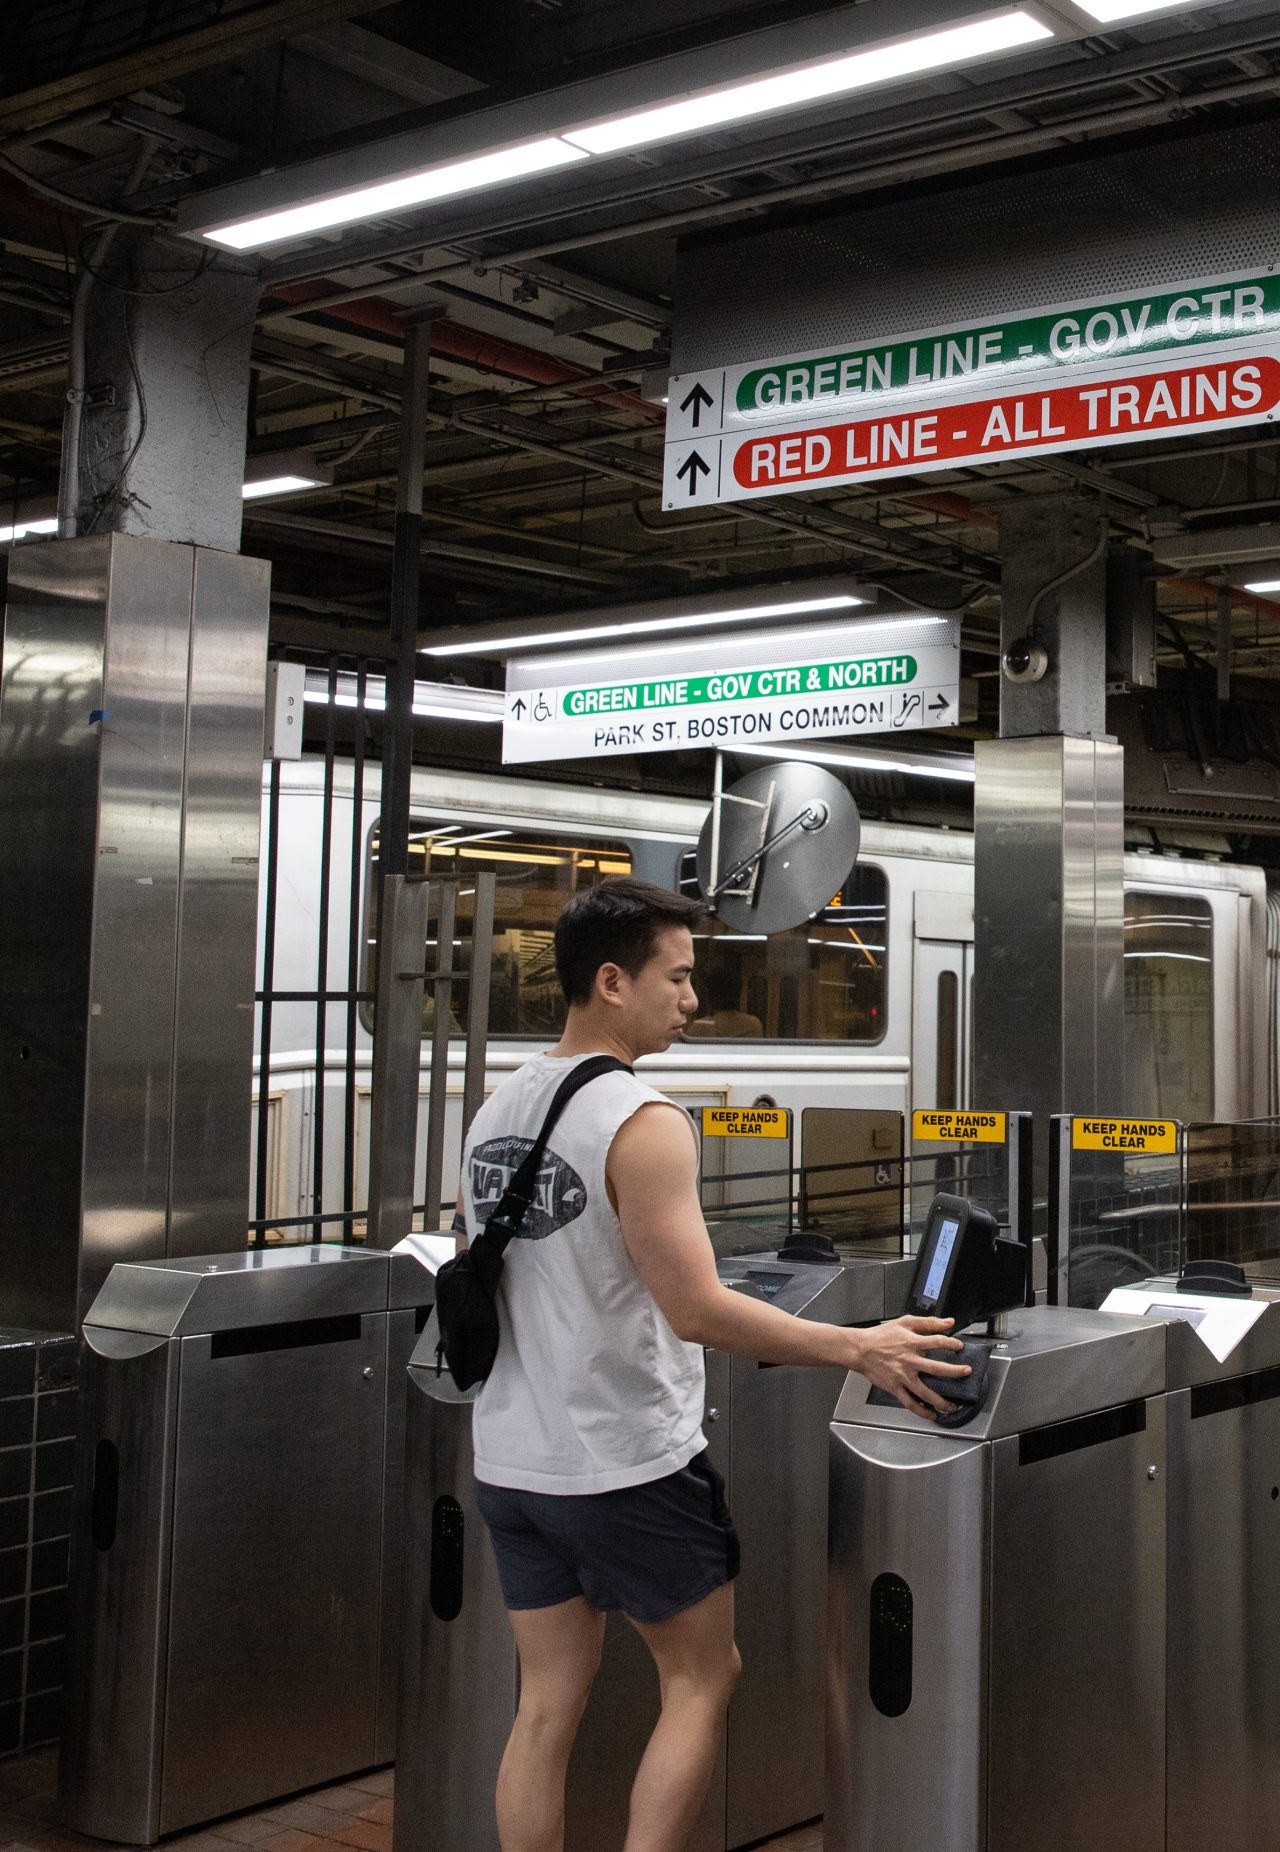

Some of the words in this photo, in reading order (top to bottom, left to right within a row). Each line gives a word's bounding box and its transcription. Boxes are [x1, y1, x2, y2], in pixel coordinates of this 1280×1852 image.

[754, 351, 893, 411] GREEN
[907, 331, 1004, 385] LINE
[1018, 343, 1035, 356] -
[1048, 306, 1150, 360] GOV
[1165, 286, 1266, 340] CTR
[750, 435, 832, 482] RED
[845, 415, 939, 468] LINE
[952, 430, 968, 440] -
[980, 398, 1067, 447] ALL
[1078, 364, 1264, 431] TRAINS
[569, 684, 636, 715] GREEN
[641, 681, 691, 709] LINE
[706, 673, 753, 701] GOV
[756, 668, 801, 697] CTR
[805, 667, 822, 691] &
[826, 658, 908, 688] NORTH
[594, 724, 646, 748] PARK
[652, 721, 681, 745] ST,
[686, 714, 773, 741] BOSTON
[781, 701, 885, 730] COMMON
[711, 1111, 745, 1123] KEEP
[746, 1112, 779, 1124] HANDS
[921, 1114, 955, 1127] KEEP
[956, 1115, 997, 1128] HANDS
[726, 1122, 763, 1135] CLEAR
[938, 1126, 979, 1139] CLEAR
[1082, 1120, 1120, 1135] KEEP
[1123, 1122, 1167, 1138] HANDS
[1101, 1134, 1147, 1149] CLEAR
